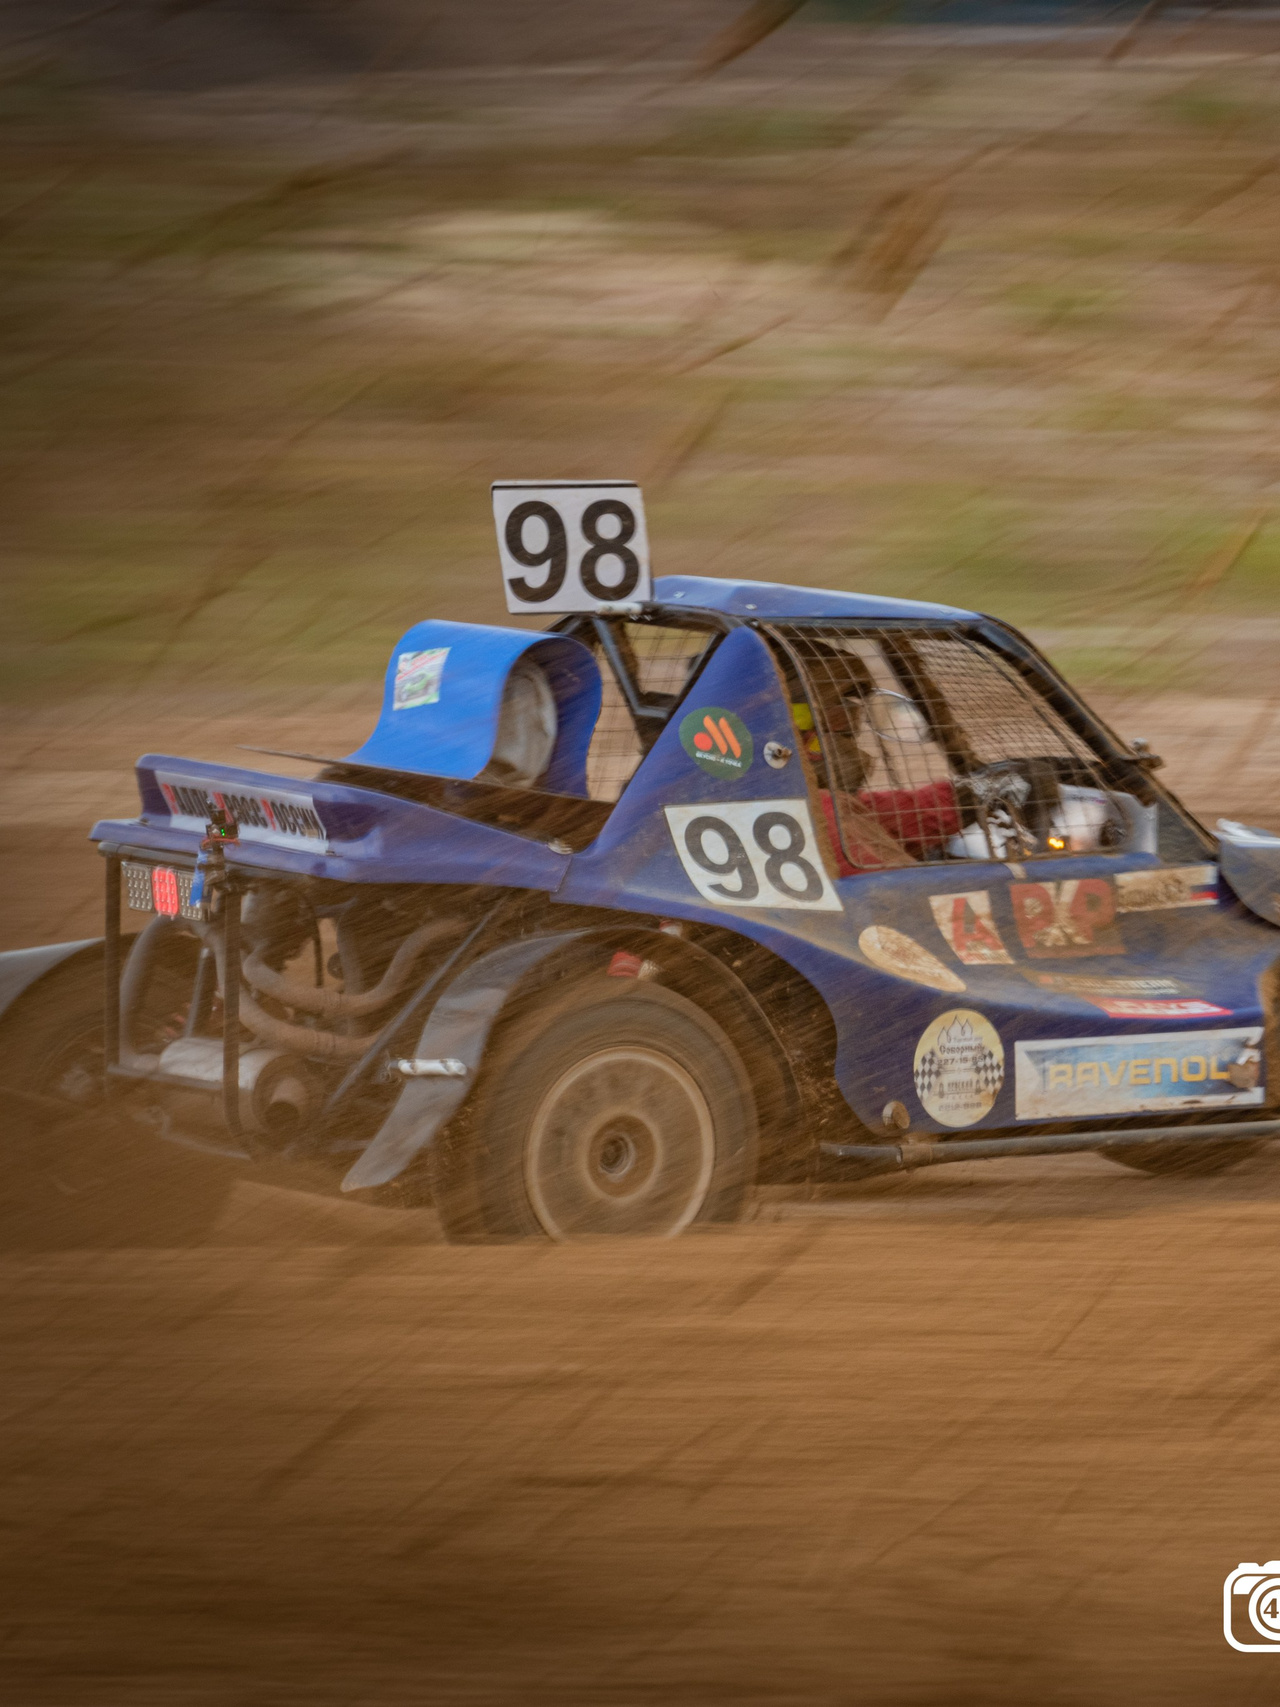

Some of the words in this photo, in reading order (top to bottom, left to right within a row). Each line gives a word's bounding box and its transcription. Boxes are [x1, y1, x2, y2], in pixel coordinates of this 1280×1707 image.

[505, 499, 640, 602] 98
[684, 811, 824, 902] 98
[1048, 1055, 1231, 1089] RAVENOL
